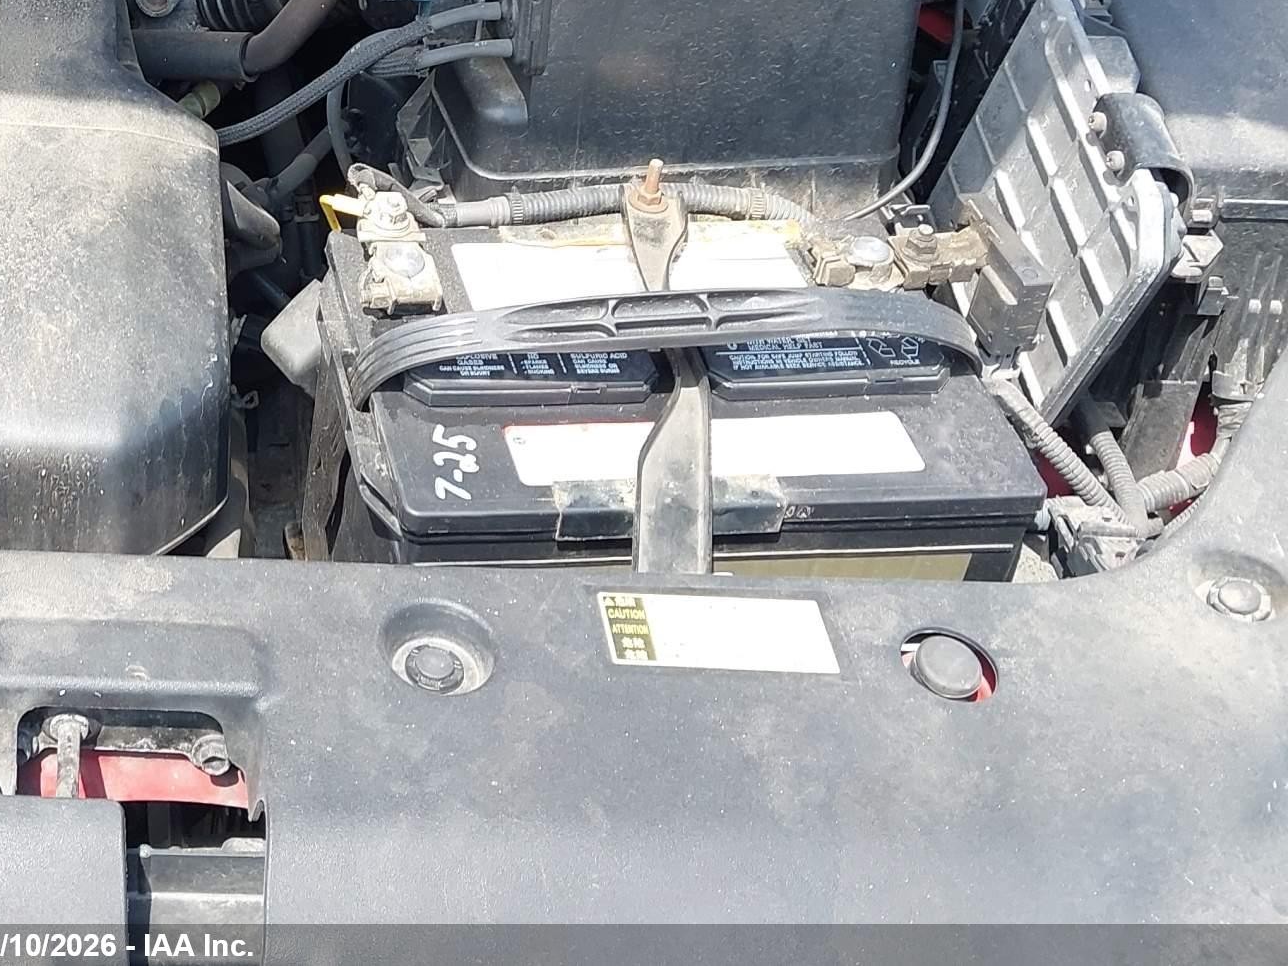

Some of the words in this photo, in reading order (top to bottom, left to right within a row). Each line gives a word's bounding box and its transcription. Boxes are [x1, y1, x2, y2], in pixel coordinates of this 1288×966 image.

[432, 423, 480, 501] 7-25
[607, 608, 646, 620] CAUTION
[612, 623, 650, 635] ATTENTION
